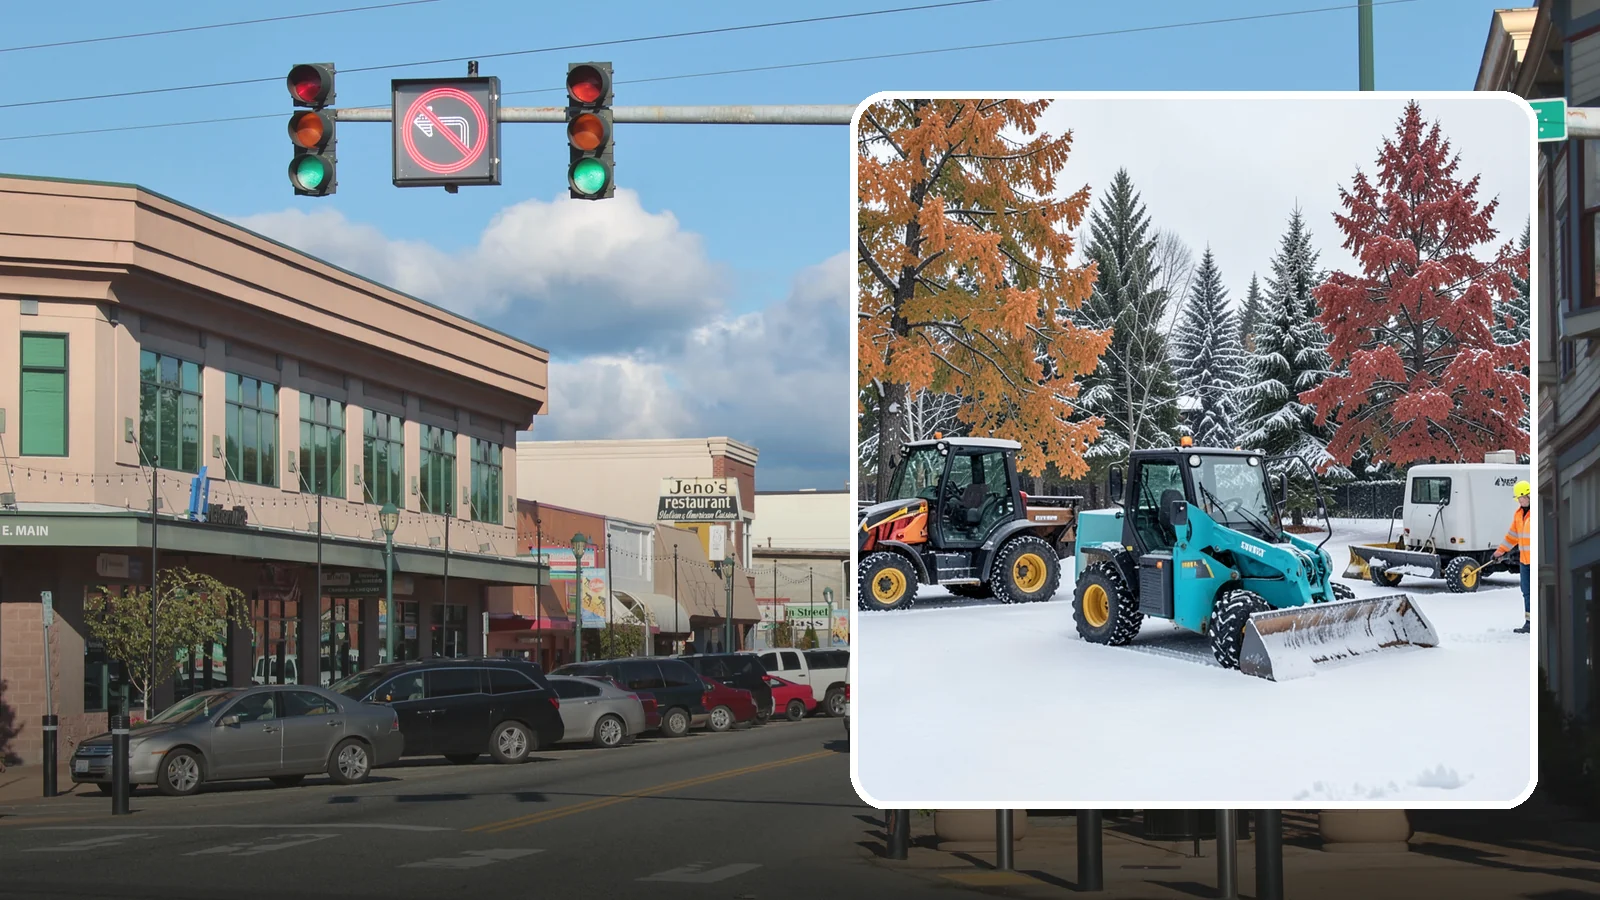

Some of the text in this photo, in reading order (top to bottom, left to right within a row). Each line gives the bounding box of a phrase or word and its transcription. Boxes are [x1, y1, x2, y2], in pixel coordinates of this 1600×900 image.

[670, 480, 727, 494] Jeno's
[664, 496, 731, 509] restaurant
[658, 510, 682, 519] Italian
[686, 509, 714, 519] American
[715, 509, 738, 519] Cuisine
[2, 525, 49, 536] E. MAIN
[797, 607, 829, 617] Street
